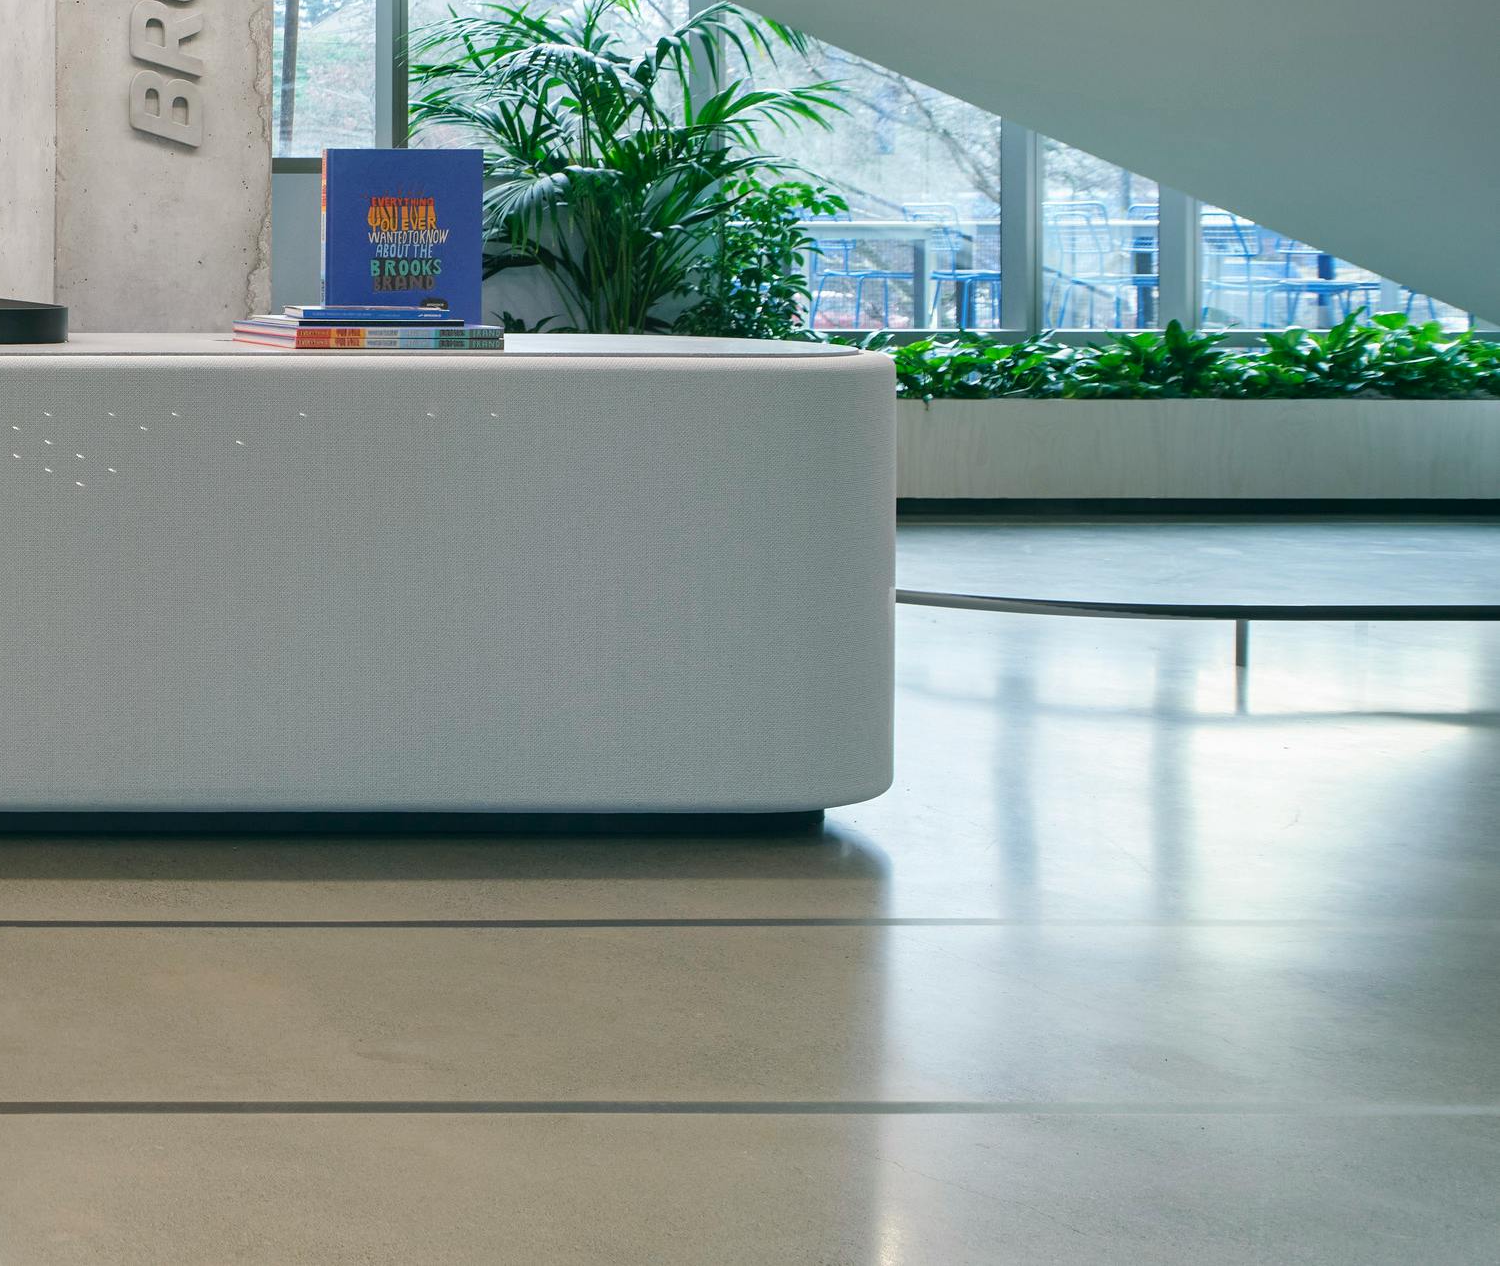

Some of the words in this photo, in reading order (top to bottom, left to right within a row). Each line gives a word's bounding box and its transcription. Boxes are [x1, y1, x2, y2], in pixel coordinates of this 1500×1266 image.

[371, 198, 434, 206] EVERYTHING
[368, 206, 398, 232] YOU
[402, 206, 437, 231] EVER
[376, 244, 410, 258] ABOUT
[414, 244, 433, 258] THE
[370, 259, 442, 276] BROOKS
[374, 276, 435, 291] BRAND
